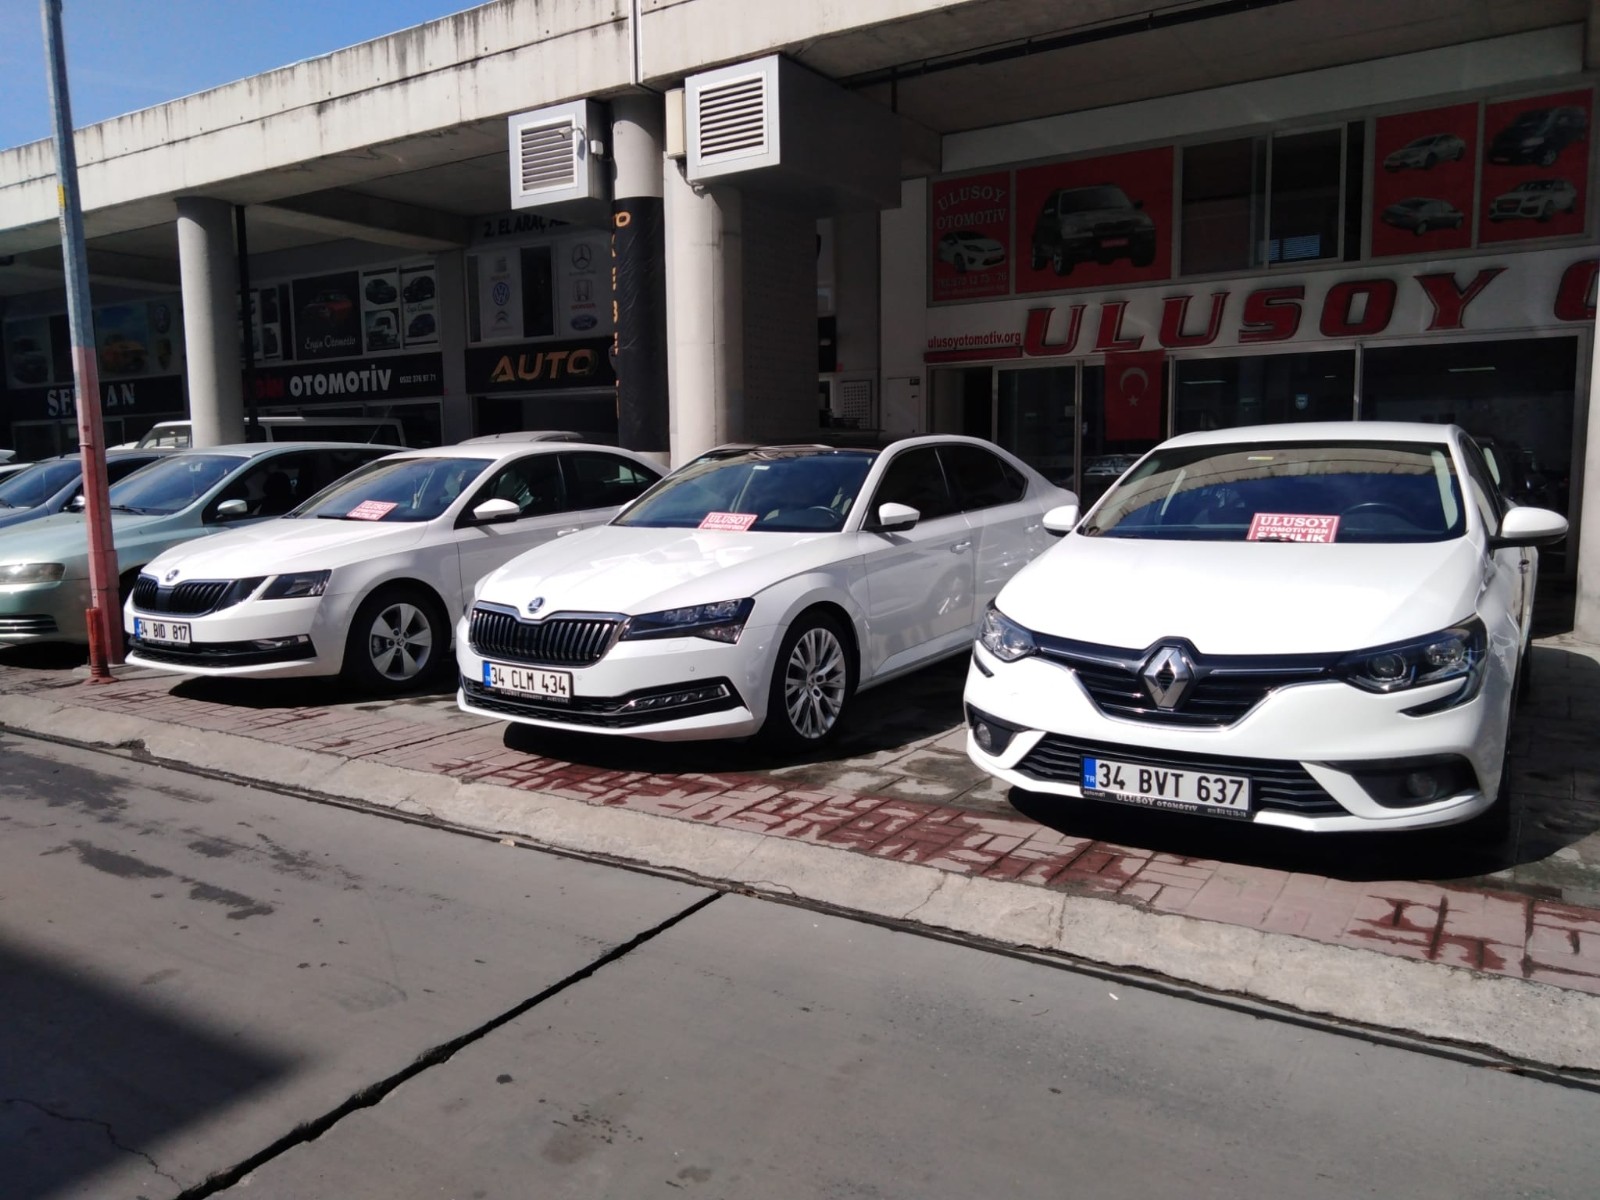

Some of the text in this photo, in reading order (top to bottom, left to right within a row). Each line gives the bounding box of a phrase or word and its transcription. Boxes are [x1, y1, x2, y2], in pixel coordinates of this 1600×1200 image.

[937, 186, 1007, 210] ULUSOY
[498, 218, 511, 235] EL
[937, 208, 1006, 230] OTOMOTİV
[1023, 267, 1507, 356] ULUSOY
[927, 330, 1021, 351] ulusoyotomotiv.org
[490, 348, 597, 383] AUTO
[289, 364, 392, 397] OTOMOTİV
[47, 383, 135, 417] SEAN
[707, 514, 754, 526] ULUSOY
[1260, 515, 1332, 528] ULUSOY
[139, 621, 148, 636] 34
[153, 622, 166, 638] BID
[172, 624, 187, 640] 817
[491, 667, 505, 686] 34
[511, 670, 535, 691] CLM
[541, 673, 566, 695] 434
[1085, 763, 1244, 806] TR 34 BVT 637
[1116, 793, 1155, 806] ULUSOY
